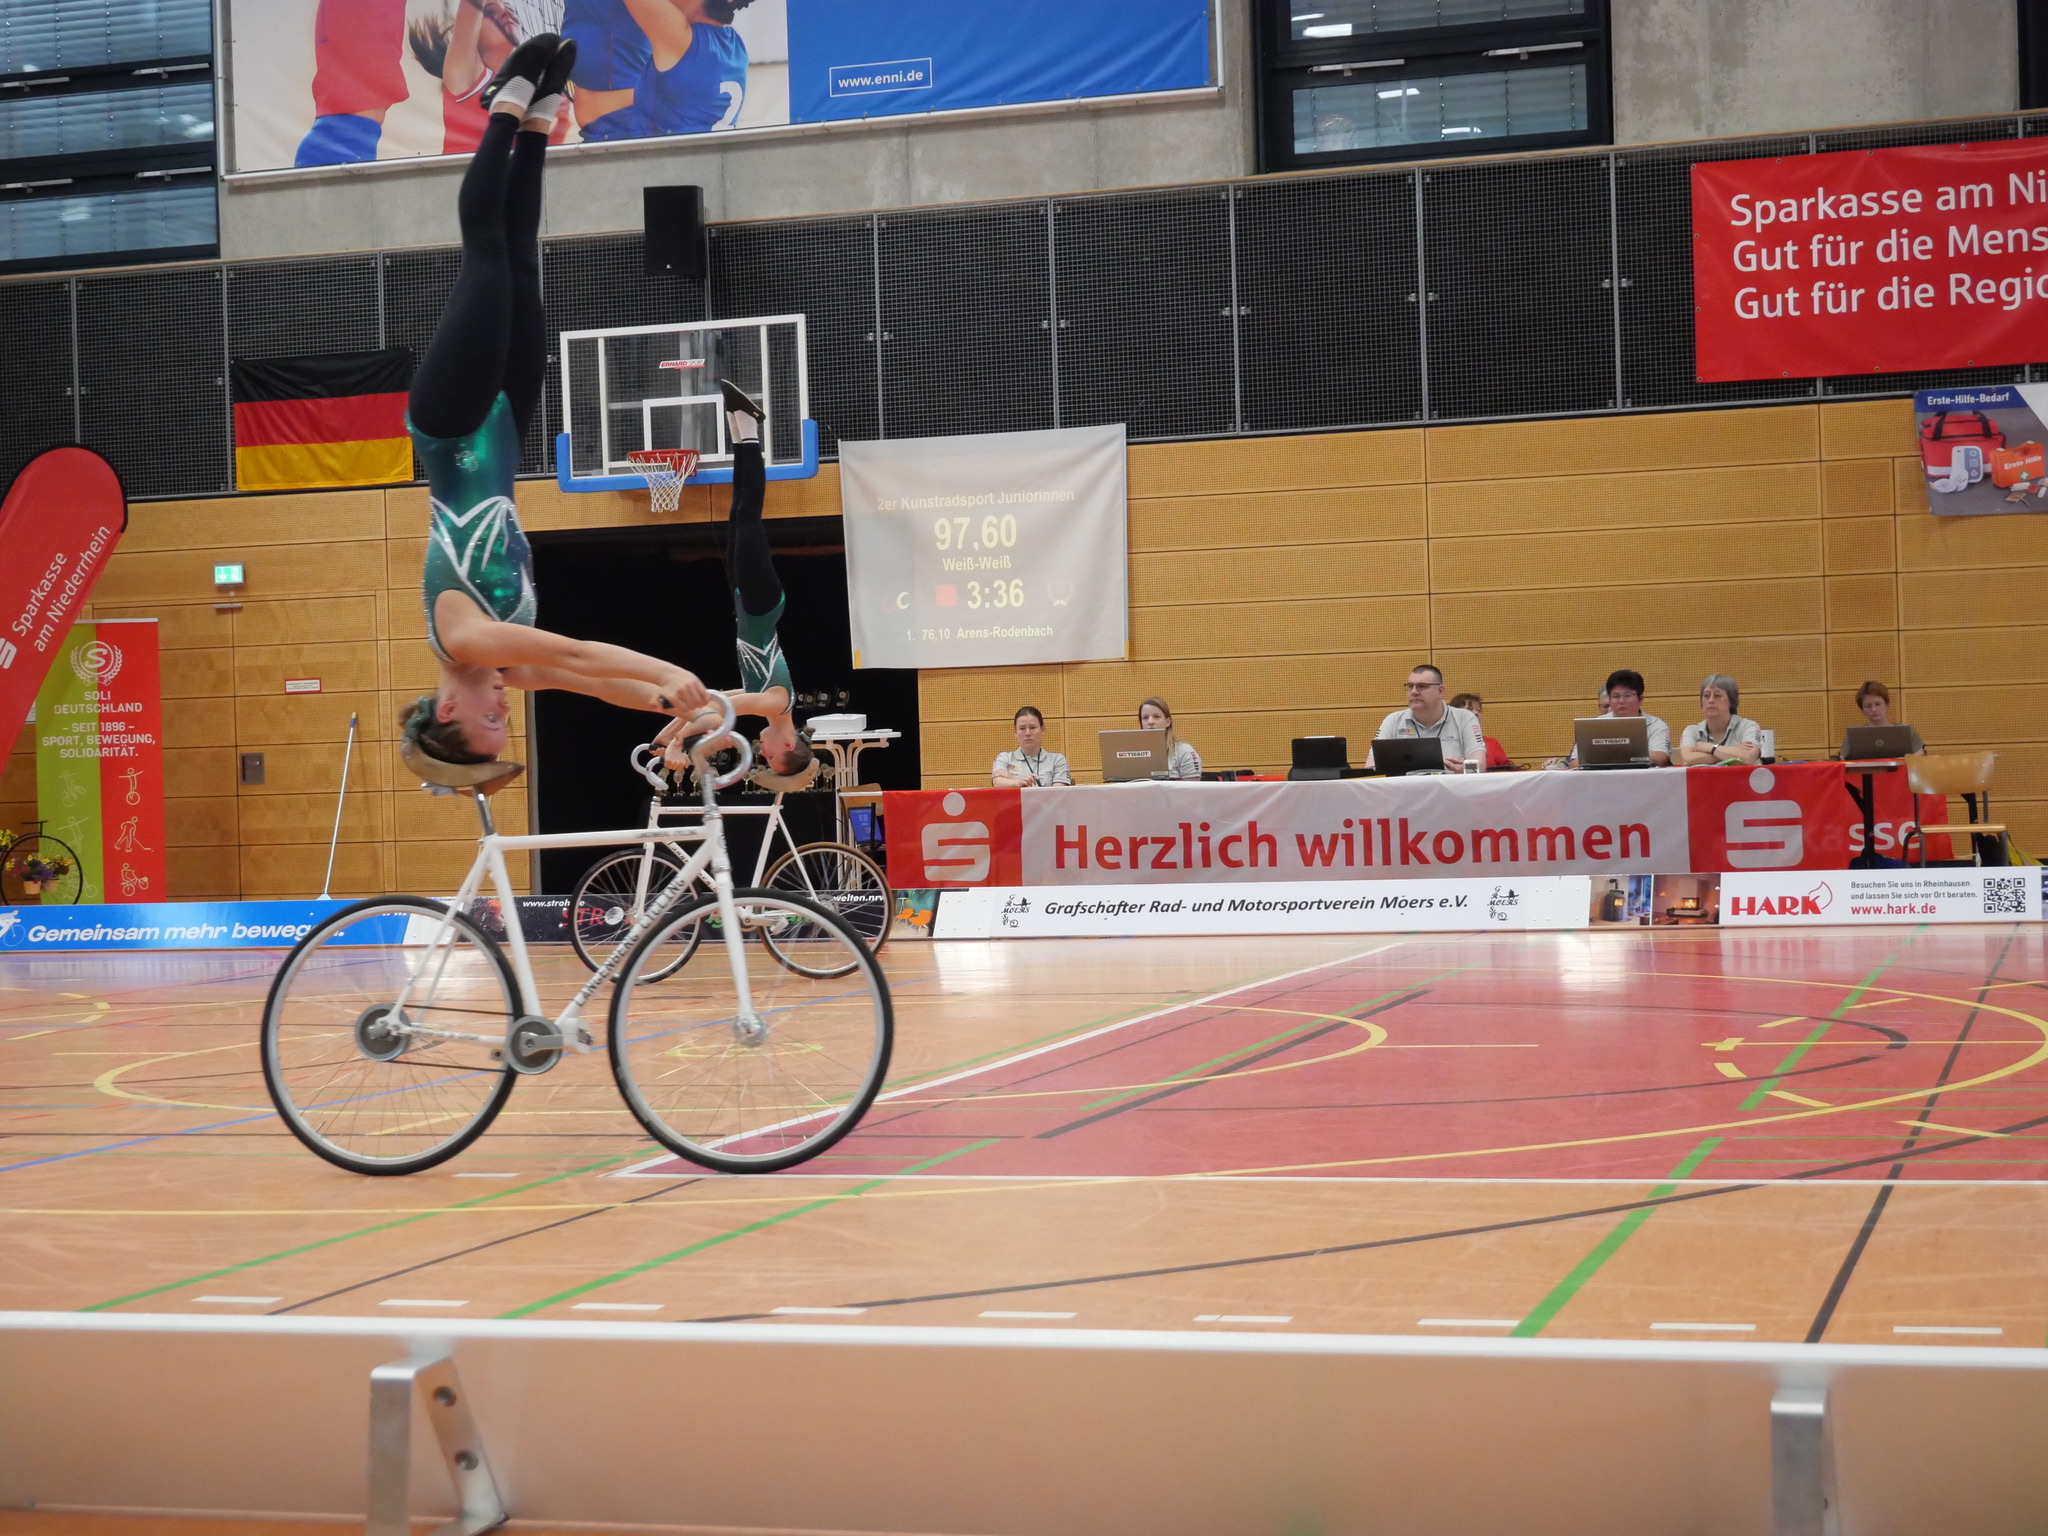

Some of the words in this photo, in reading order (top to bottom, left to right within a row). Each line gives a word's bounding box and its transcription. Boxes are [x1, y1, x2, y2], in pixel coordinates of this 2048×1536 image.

[838, 70, 923, 88] www.enni.de
[1730, 186, 1923, 233] Sparkasse
[1936, 182, 1993, 211] am
[2009, 170, 2048, 205] Ni
[1733, 239, 1800, 272] Gut
[1809, 234, 1864, 267] für
[1876, 228, 1933, 263] die
[1734, 287, 1801, 319] Gut
[1811, 281, 1865, 314] für
[1877, 275, 1935, 310] die
[1927, 392, 2010, 406] Erste-Hilfe-Bedarf
[2004, 460, 2024, 470] Erste
[2025, 455, 2042, 464] Hilfe
[877, 498, 897, 511] 2er
[901, 491, 994, 510] Kunstradsport
[998, 489, 1074, 503] Juniorinnen
[934, 514, 1017, 551] 97,60
[942, 555, 1012, 571] Weiß-Weiß
[12, 552, 68, 637] Sparkasse
[34, 624, 55, 652] am
[46, 525, 110, 623] Niederrhein
[967, 579, 1024, 609] 3:36
[906, 630, 915, 641] 1.
[922, 628, 951, 642] 76,10
[956, 625, 1053, 640] Arens-Rodenbach
[84, 691, 111, 701] SOLI
[54, 702, 143, 714] DEUTSCHLAND
[72, 722, 97, 732] SEIT
[100, 722, 126, 732] 1896
[42, 735, 84, 747] SPORT,
[86, 734, 156, 745] BEWEGUNG,
[60, 744, 139, 758] SOLIDARITÄT.
[1055, 821, 1278, 870] Herzlich
[1295, 818, 1650, 867] willkommen
[1851, 881, 1886, 889] Besuchen
[1914, 880, 1922, 888] in
[1923, 880, 1970, 888] Rheinhausen
[1045, 900, 1146, 917] Grafschafter
[1149, 900, 1187, 914] Rad-
[1191, 899, 1223, 913] und
[1227, 896, 1375, 914] Motorsportverein
[1380, 895, 1434, 909] Moers
[1439, 895, 1468, 908] e.V.
[1731, 896, 1822, 915] HARK
[1851, 903, 1936, 915] www.hark.de
[28, 923, 159, 942] Gemeinsam
[164, 922, 228, 940] mehr
